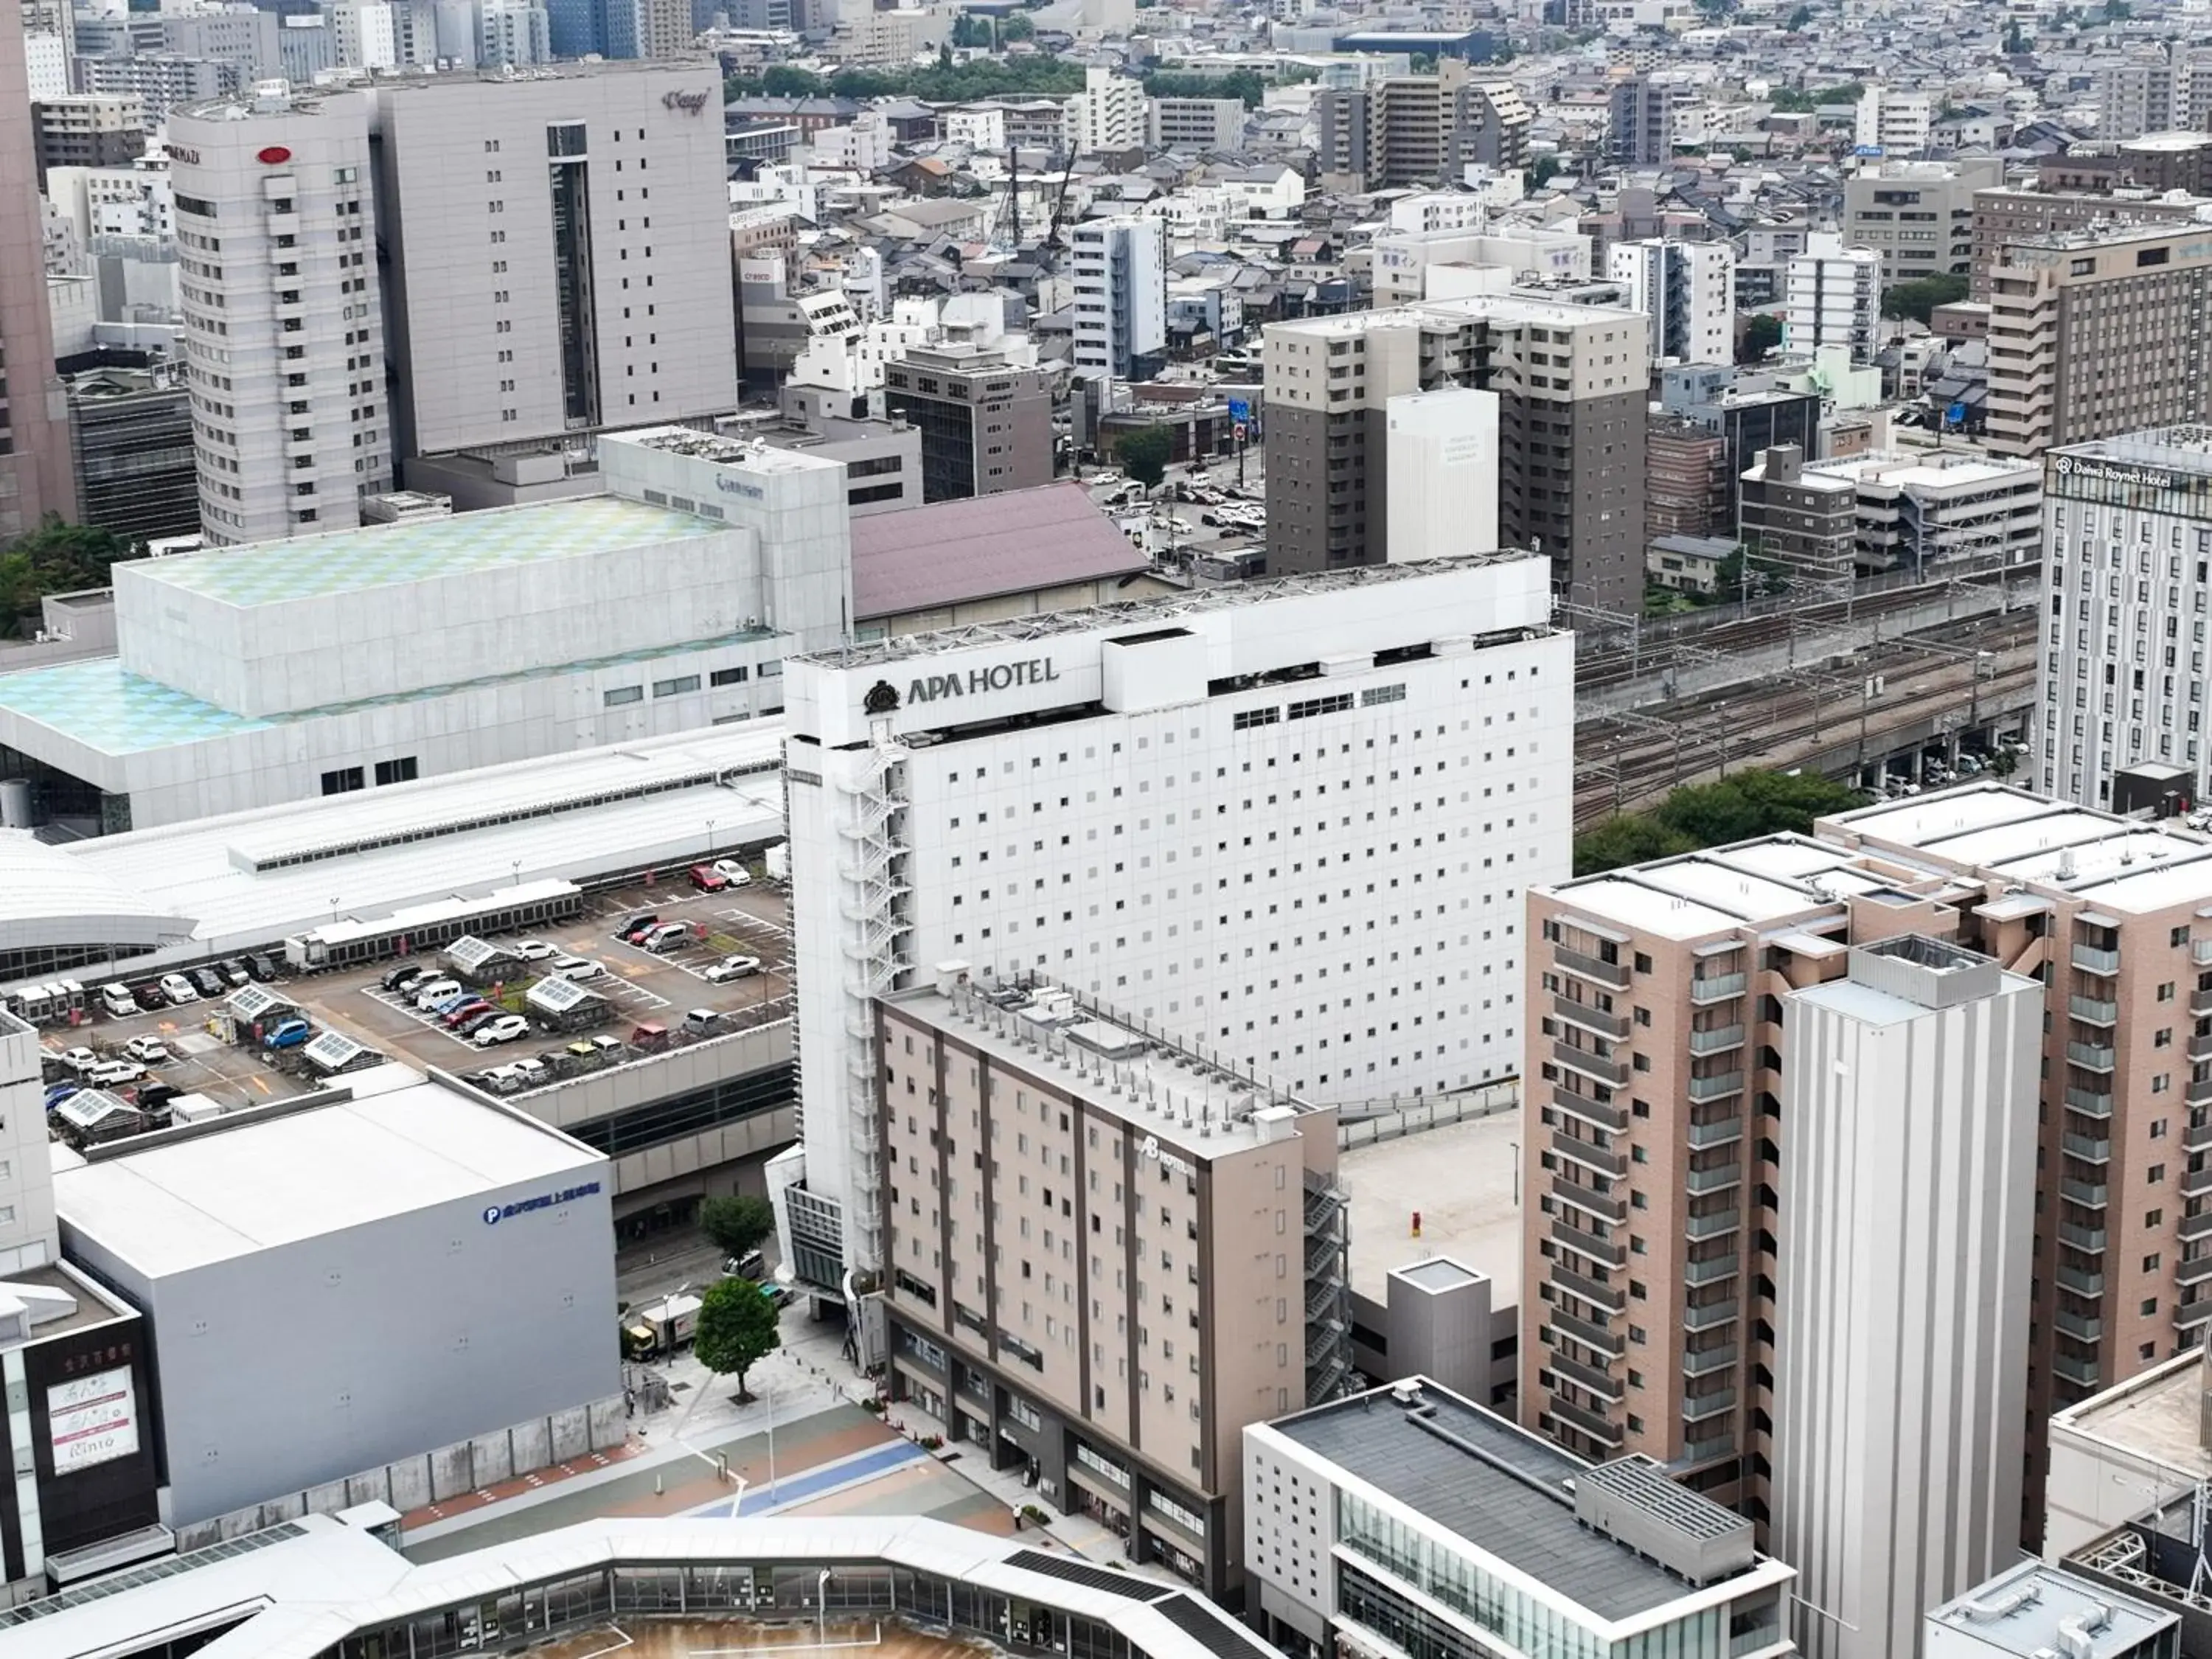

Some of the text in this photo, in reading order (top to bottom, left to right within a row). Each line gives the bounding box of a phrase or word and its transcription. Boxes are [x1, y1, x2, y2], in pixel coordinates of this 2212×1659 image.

[2073, 462, 2171, 488] Daiwa Roynet Hotel
[908, 672, 964, 705] APA
[969, 657, 1060, 694] HOTEL
